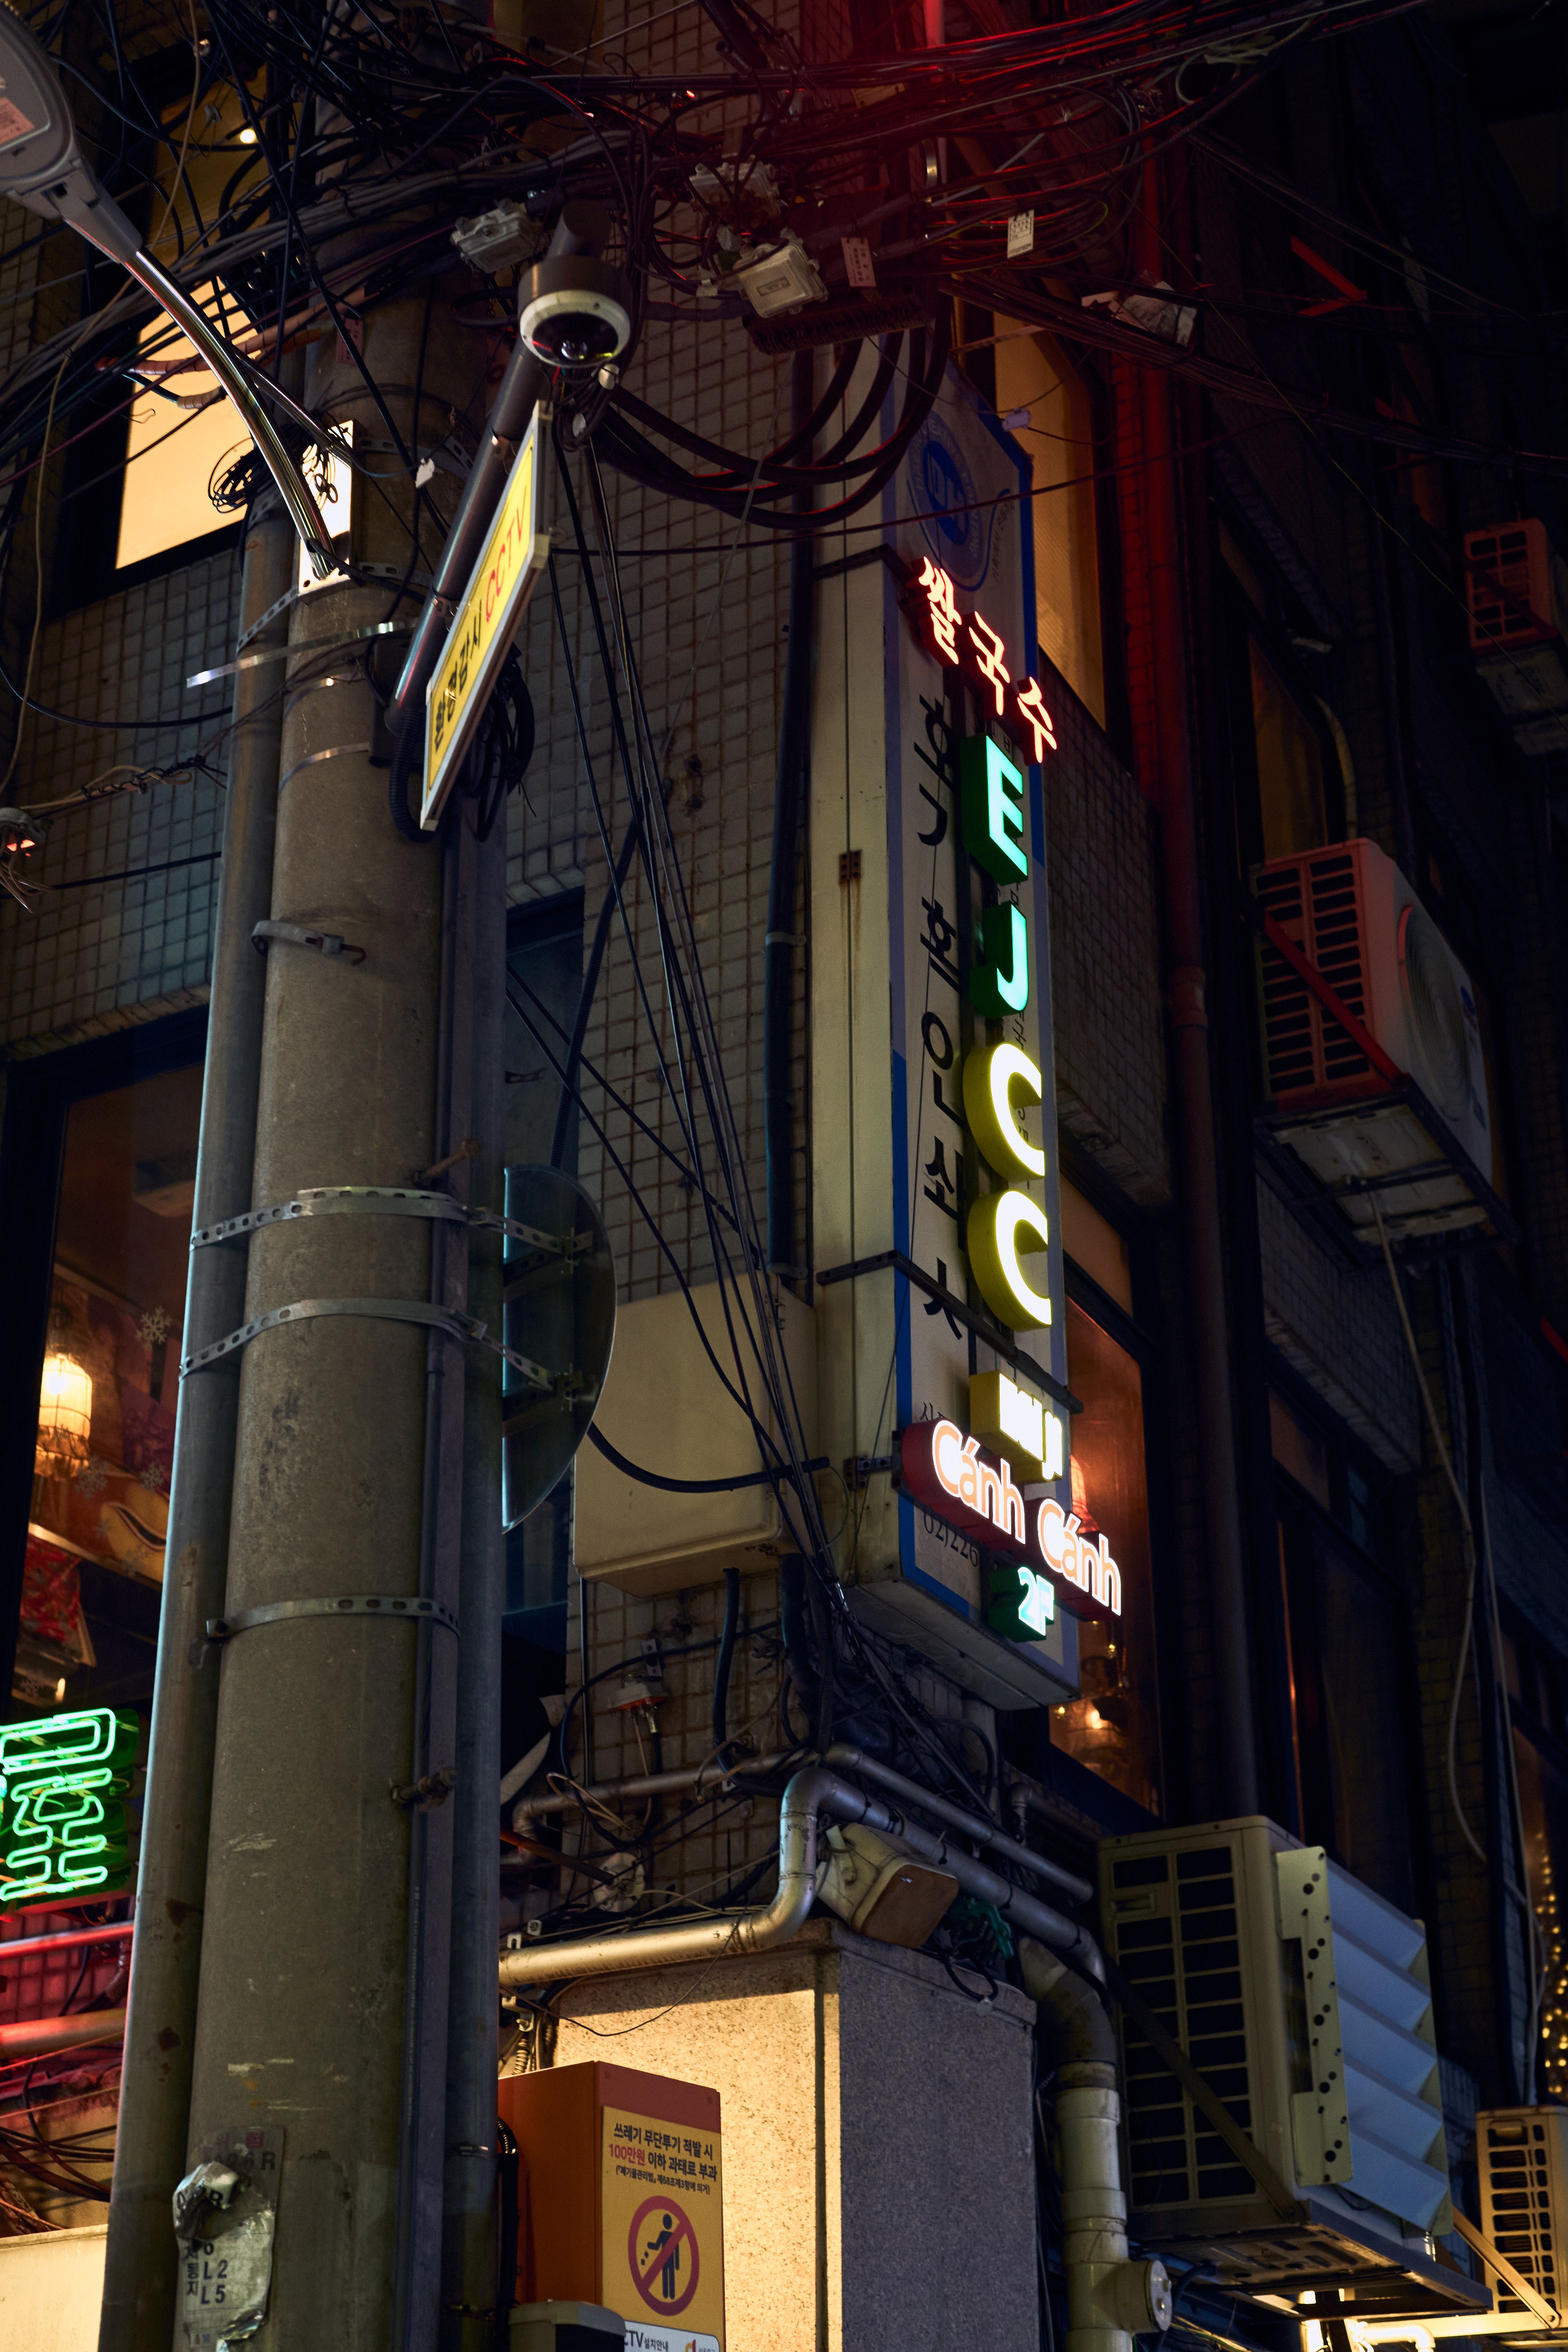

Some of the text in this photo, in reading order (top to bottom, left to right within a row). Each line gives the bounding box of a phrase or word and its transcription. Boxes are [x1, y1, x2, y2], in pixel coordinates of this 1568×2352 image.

[486, 485, 527, 622] CCTV
[919, 556, 1057, 764] 쌀국수
[932, 1420, 1026, 1544] Cánh
[1037, 1498, 1121, 1616] Cánh
[1018, 1566, 1054, 1635] 2F
[609, 2144, 717, 2182] 100만원 이하 과태료 부과
[614, 2123, 713, 2161] 쓰레기 무단투기 적발 시
